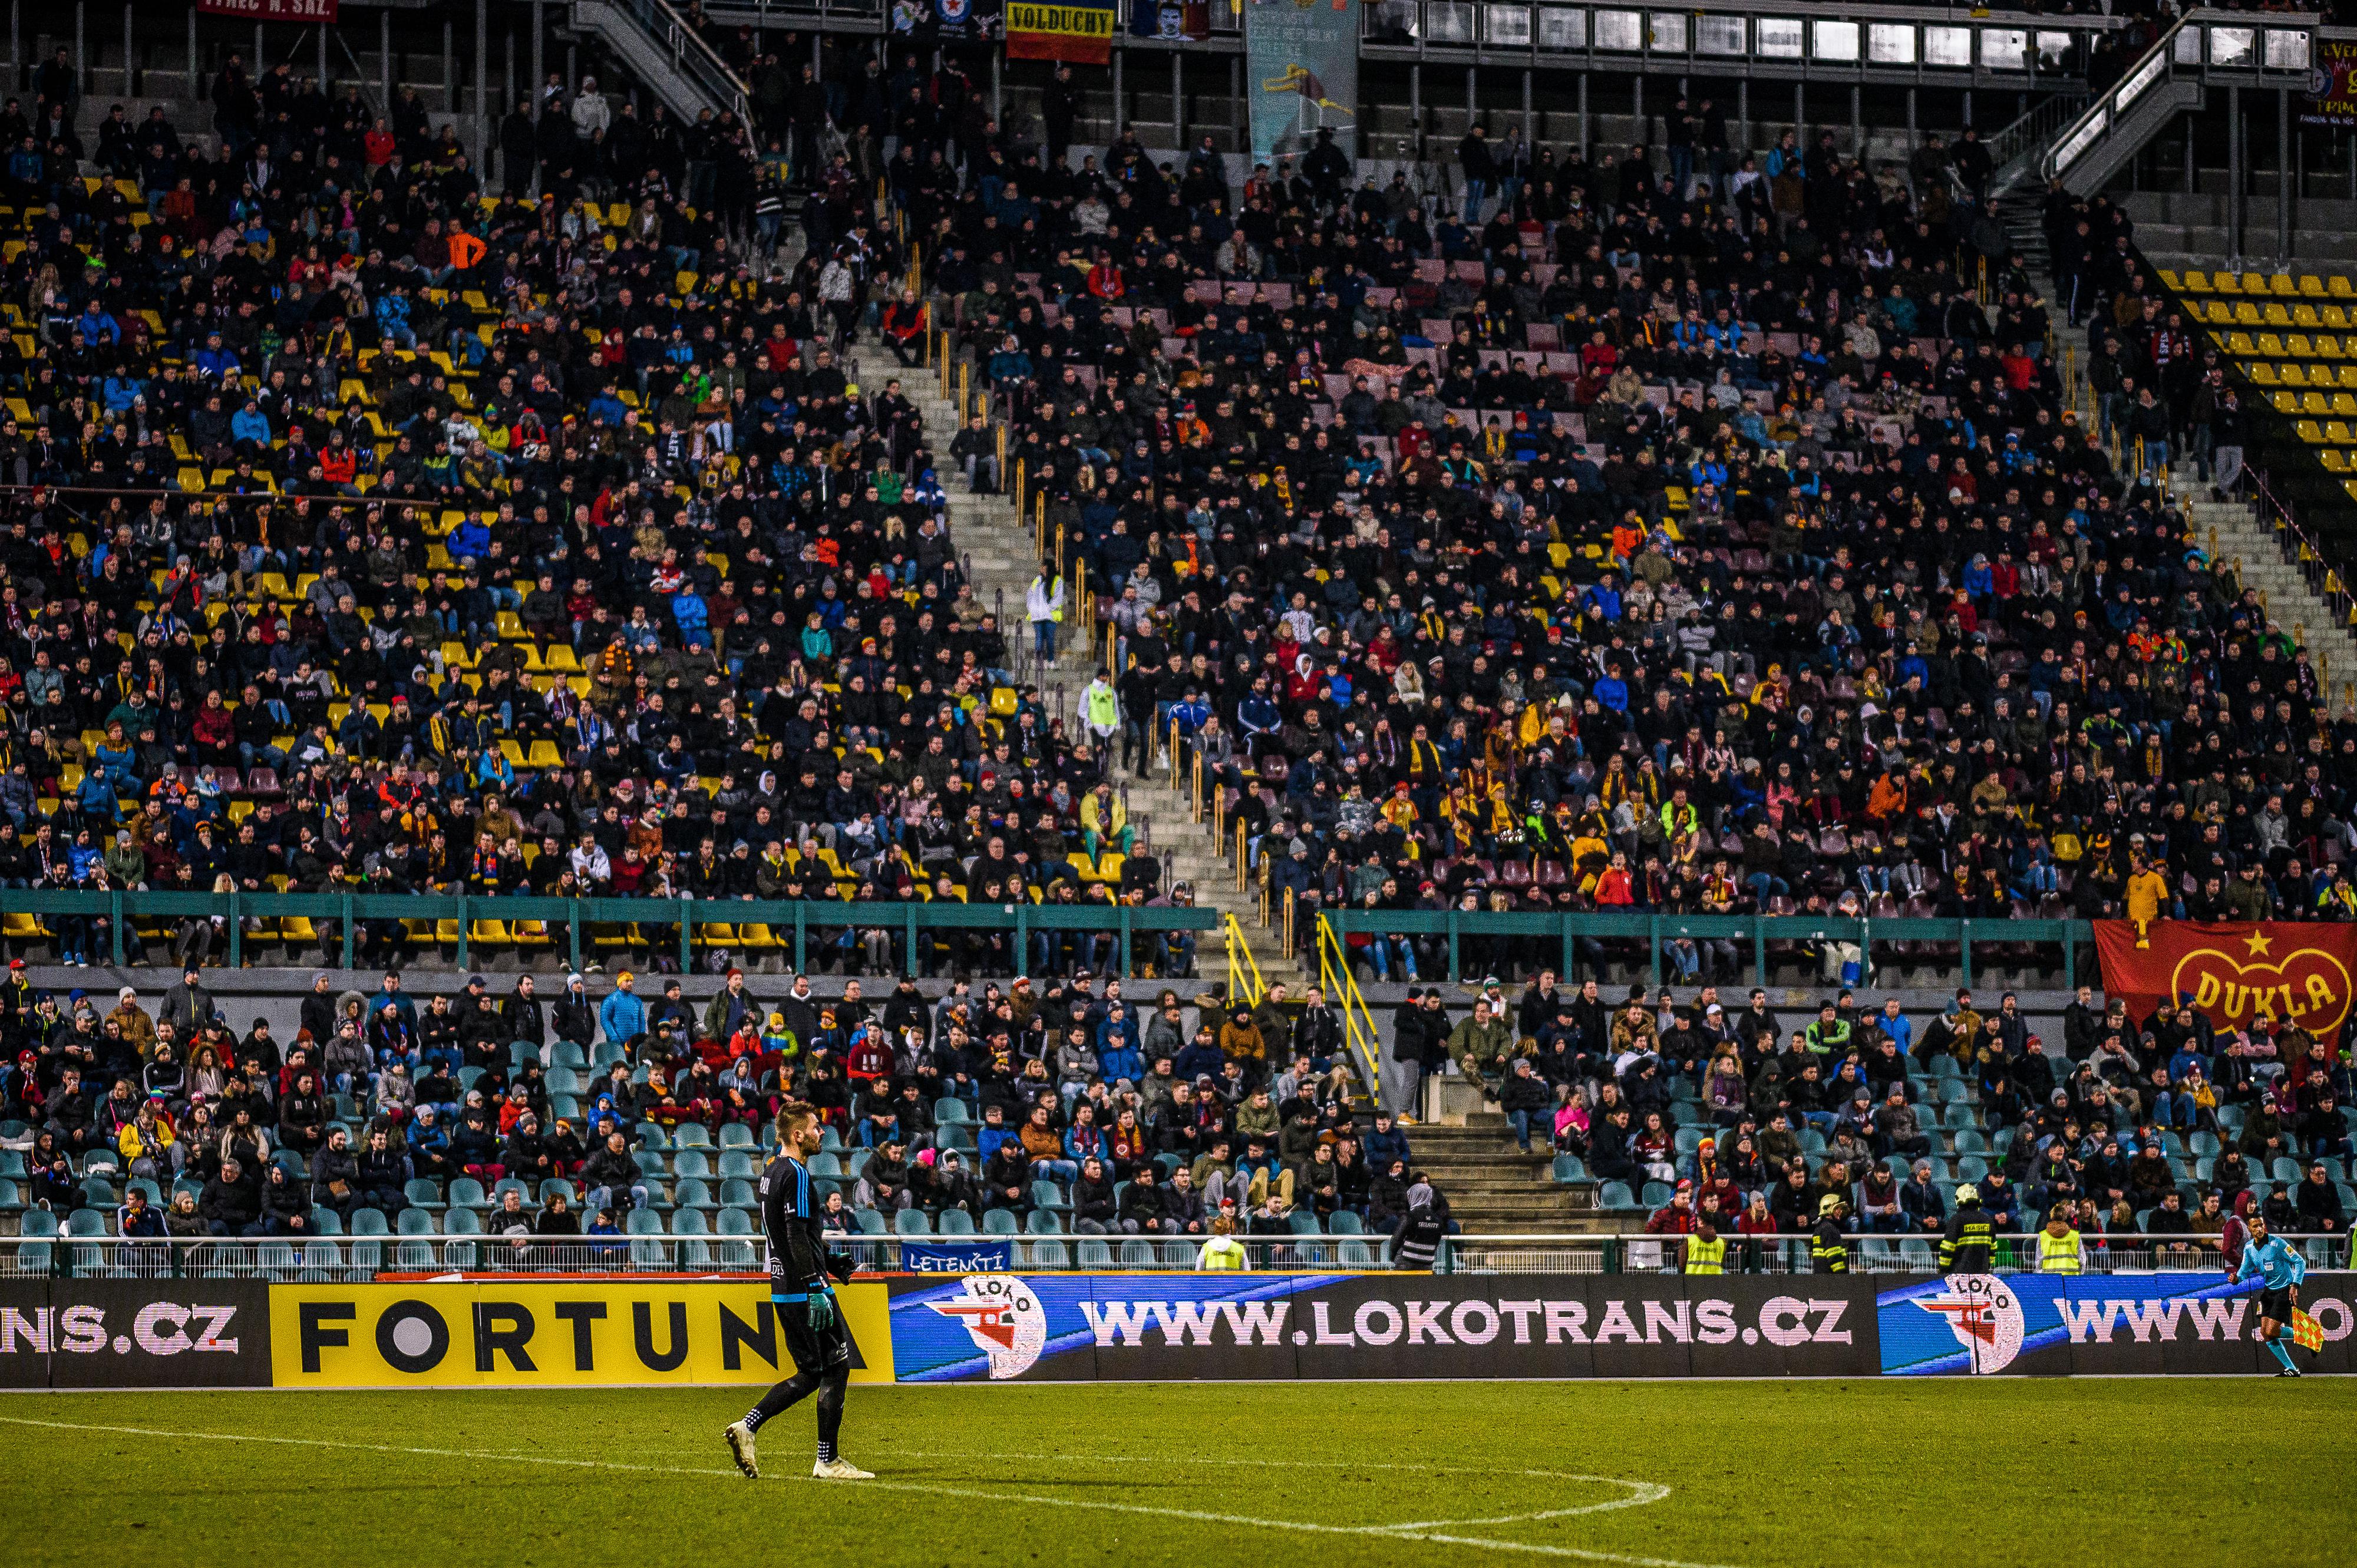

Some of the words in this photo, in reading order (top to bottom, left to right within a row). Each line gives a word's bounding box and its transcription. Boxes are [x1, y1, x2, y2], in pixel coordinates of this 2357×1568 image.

[1013, 6, 1108, 33] VOLDUCHY
[2194, 970, 2336, 1022] DUKLA
[910, 1251, 1003, 1272] LETENŠTÍ
[974, 1280, 1031, 1312] LOKO
[1956, 1277, 2009, 1310] LOKO
[1078, 1296, 1853, 1347] WWW.LOKOTRANS.CZ
